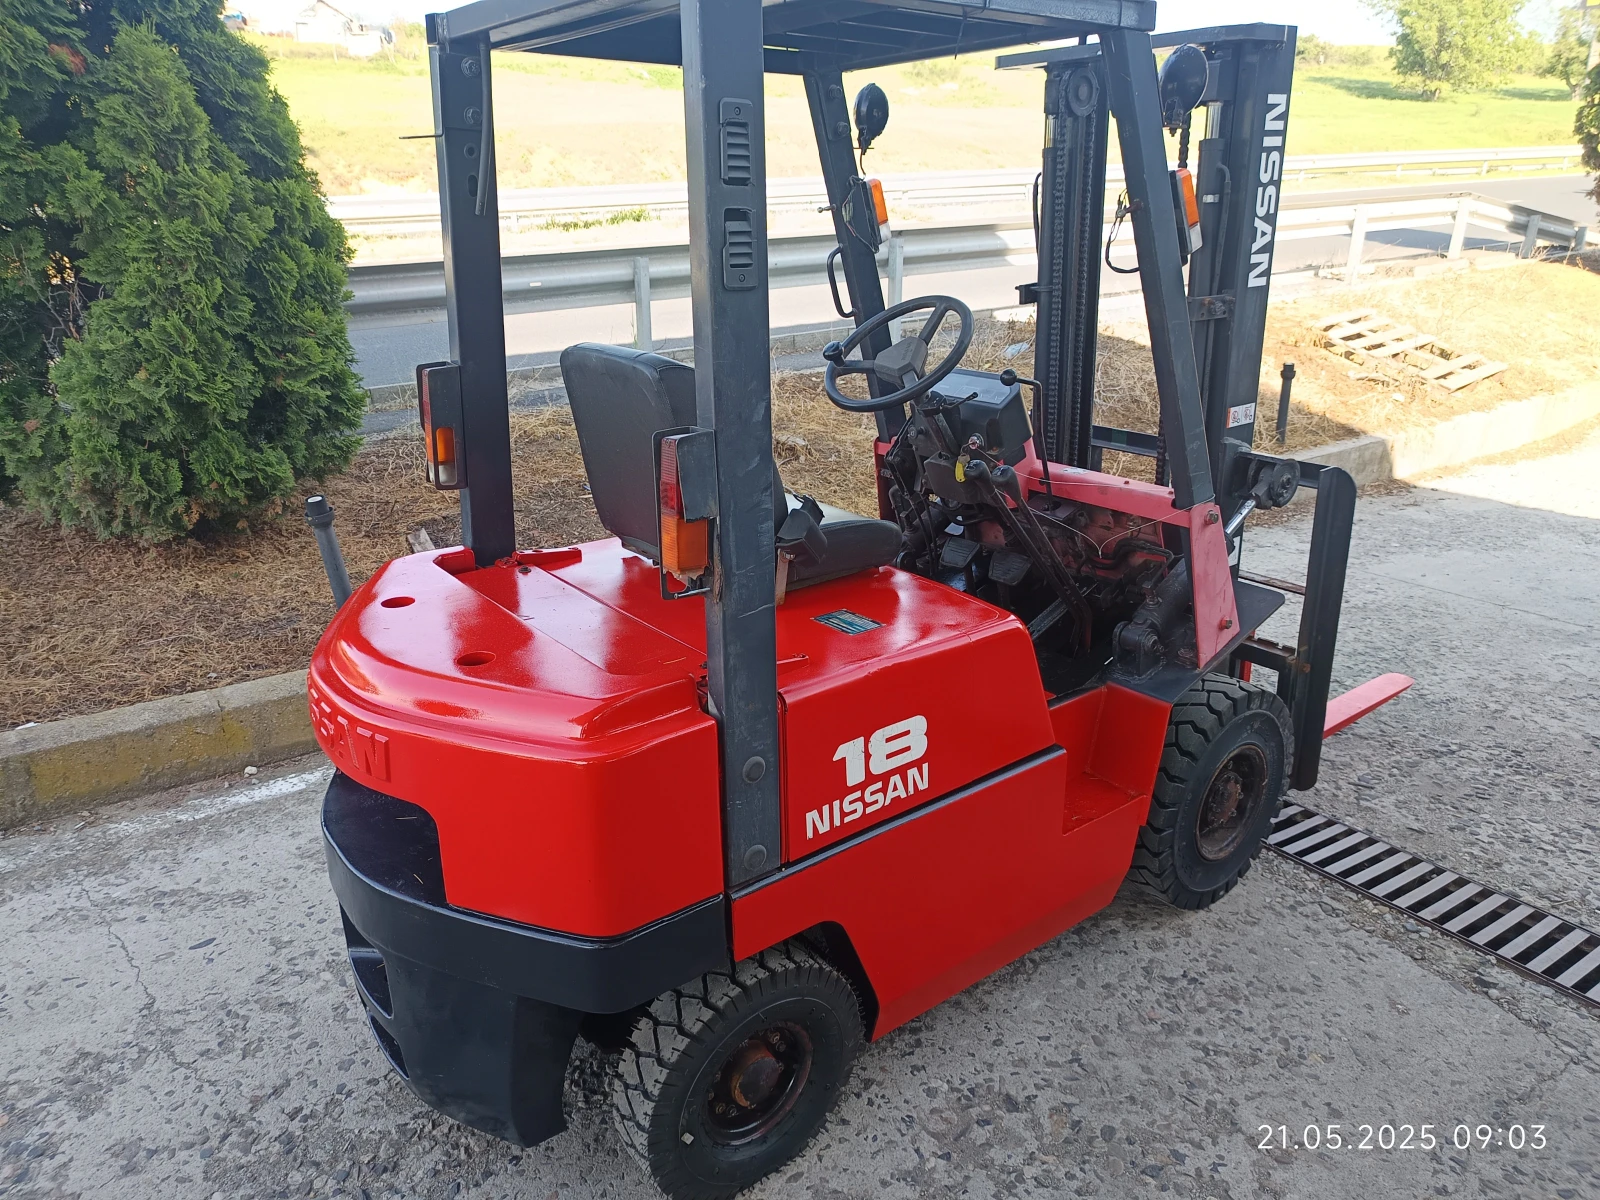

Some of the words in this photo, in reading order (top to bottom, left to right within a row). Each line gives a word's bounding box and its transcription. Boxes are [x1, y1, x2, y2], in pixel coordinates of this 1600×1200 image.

[1247, 93, 1288, 288] NISSAN
[832, 715, 928, 787] 18
[805, 762, 929, 841] NISSAN
